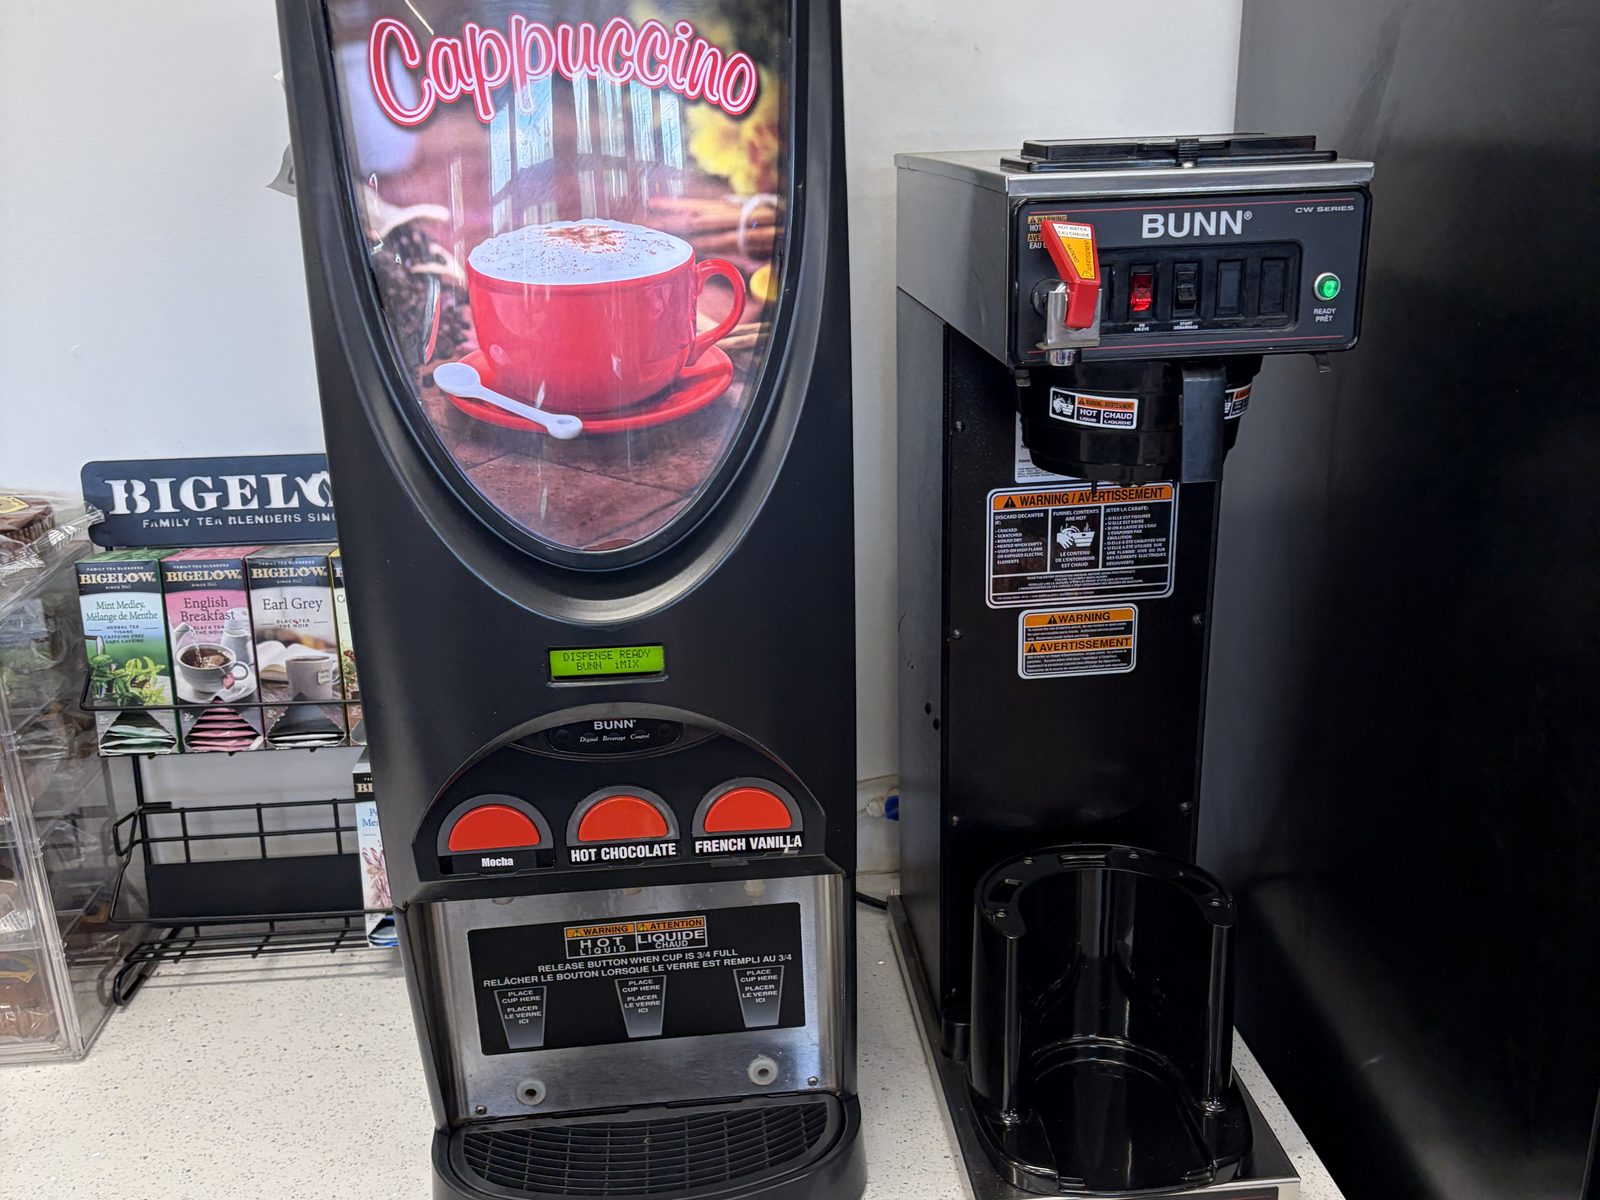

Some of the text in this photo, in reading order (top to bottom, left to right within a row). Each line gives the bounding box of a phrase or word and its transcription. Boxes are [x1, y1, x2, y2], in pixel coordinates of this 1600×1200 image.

[369, 15, 759, 125] Cappuccino
[1080, 408, 1098, 417] HOT
[1104, 412, 1133, 420] CHAUD
[1020, 493, 1069, 507] WARNING
[1078, 487, 1165, 503] AVERTISSEMENT
[143, 517, 191, 529] FAMILY
[197, 517, 223, 527] TEA
[229, 514, 302, 525] BLENDERS
[96, 601, 115, 610] Mint
[184, 596, 228, 612] English
[262, 597, 288, 611] Earl
[291, 597, 323, 612] Grey
[87, 611, 158, 623] Mélange de Menthe
[180, 609, 235, 622] Breakfast
[1058, 612, 1110, 624] WARNING
[1040, 638, 1130, 652] AVERTISSEMENT
[563, 649, 651, 662] DISPENSE READY
[577, 661, 602, 671] BUNN
[695, 835, 802, 853] FRENCH VANILLA
[571, 843, 677, 863] HOT CHOCOLATE
[482, 857, 514, 867] Mocha
[650, 919, 702, 929] ATTENTION
[583, 926, 628, 936] WARNING
[638, 930, 705, 944] LIQUIDE
[580, 937, 623, 949] HOT
[655, 941, 688, 949] CHAUD
[580, 945, 626, 956] LIQUID
[538, 949, 738, 973] RELEASE BUTTON WHEN CUP IS 3/4 FULL
[483, 954, 792, 987] RELÂCHER LE BOUTON LORSQUE LE VERRE EST REMPLI AU 3/4
